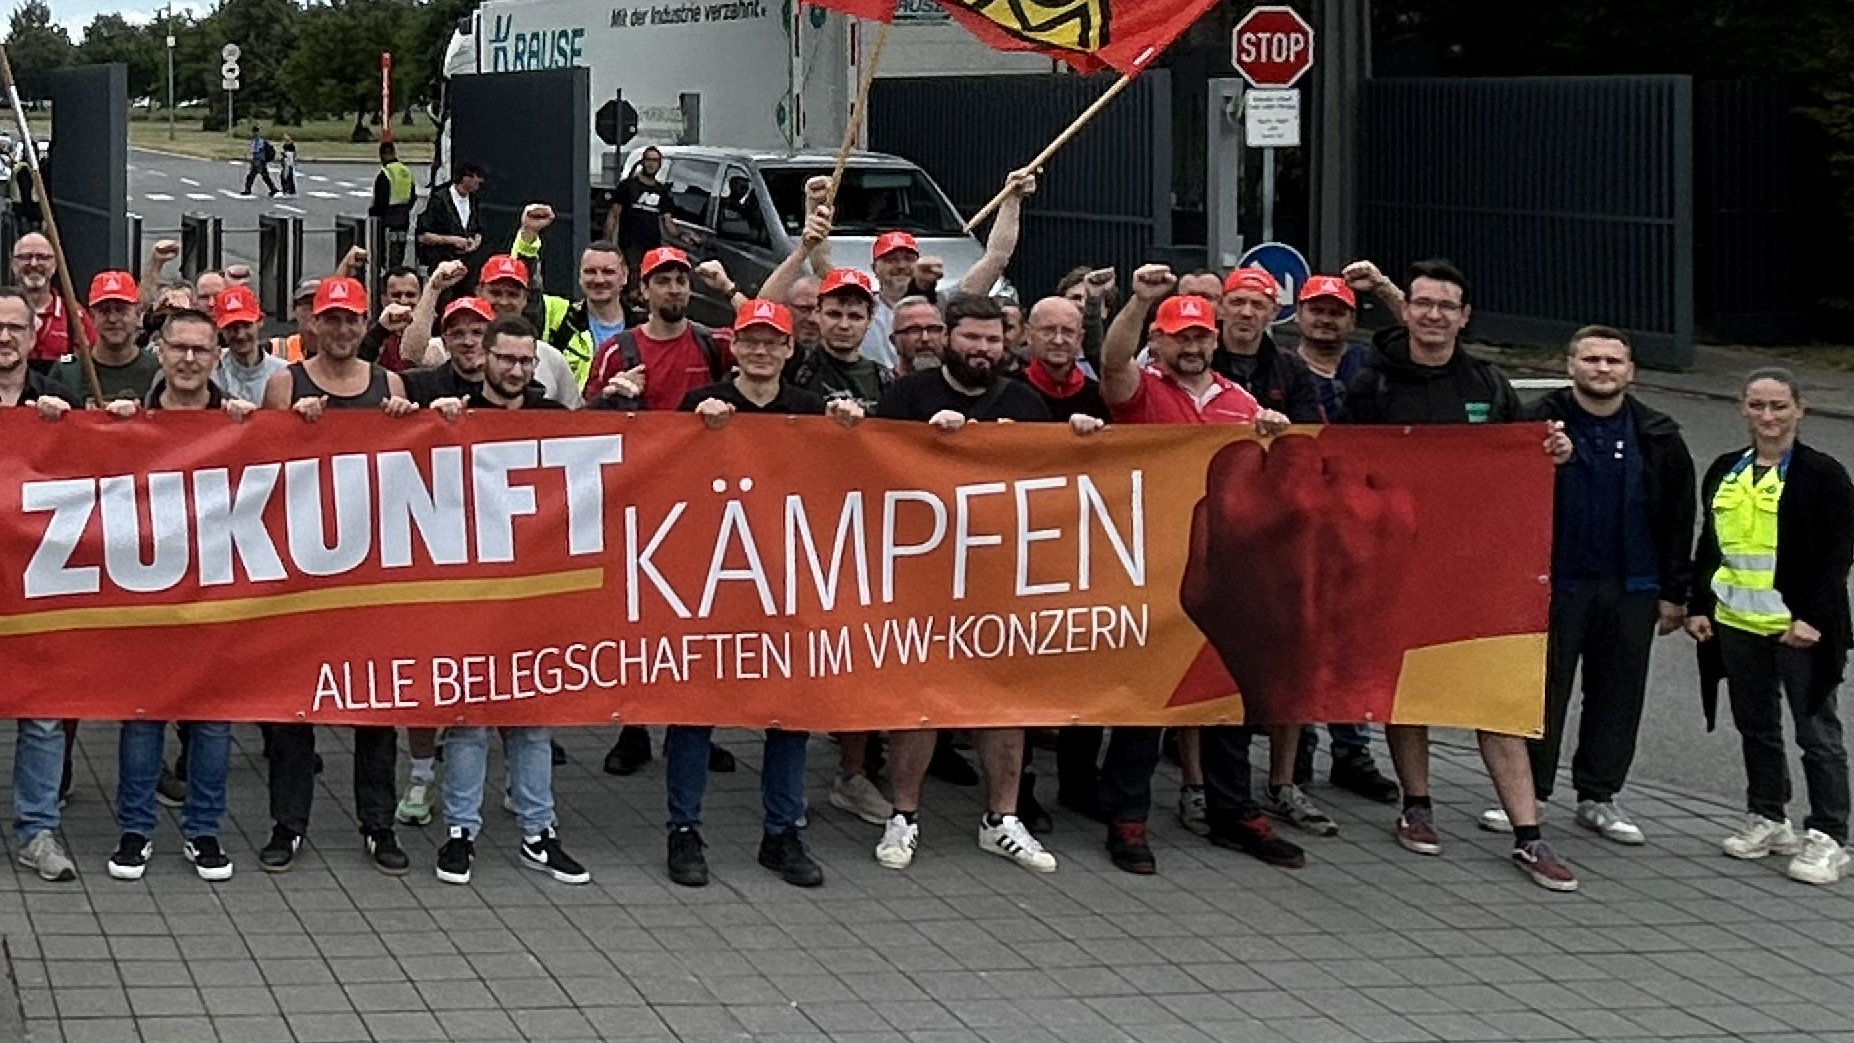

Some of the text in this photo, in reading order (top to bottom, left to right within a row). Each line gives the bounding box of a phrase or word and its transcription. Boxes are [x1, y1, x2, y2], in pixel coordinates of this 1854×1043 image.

[489, 13, 585, 72] KRAUSE
[631, 7, 649, 27] der
[1240, 31, 1305, 63] STOP
[22, 434, 624, 599] ZUKUNFT
[624, 469, 1147, 622] KÄMPFEN
[312, 604, 1148, 712] ALLE BELEGSCHAFTEN IM VW-KONZERN
